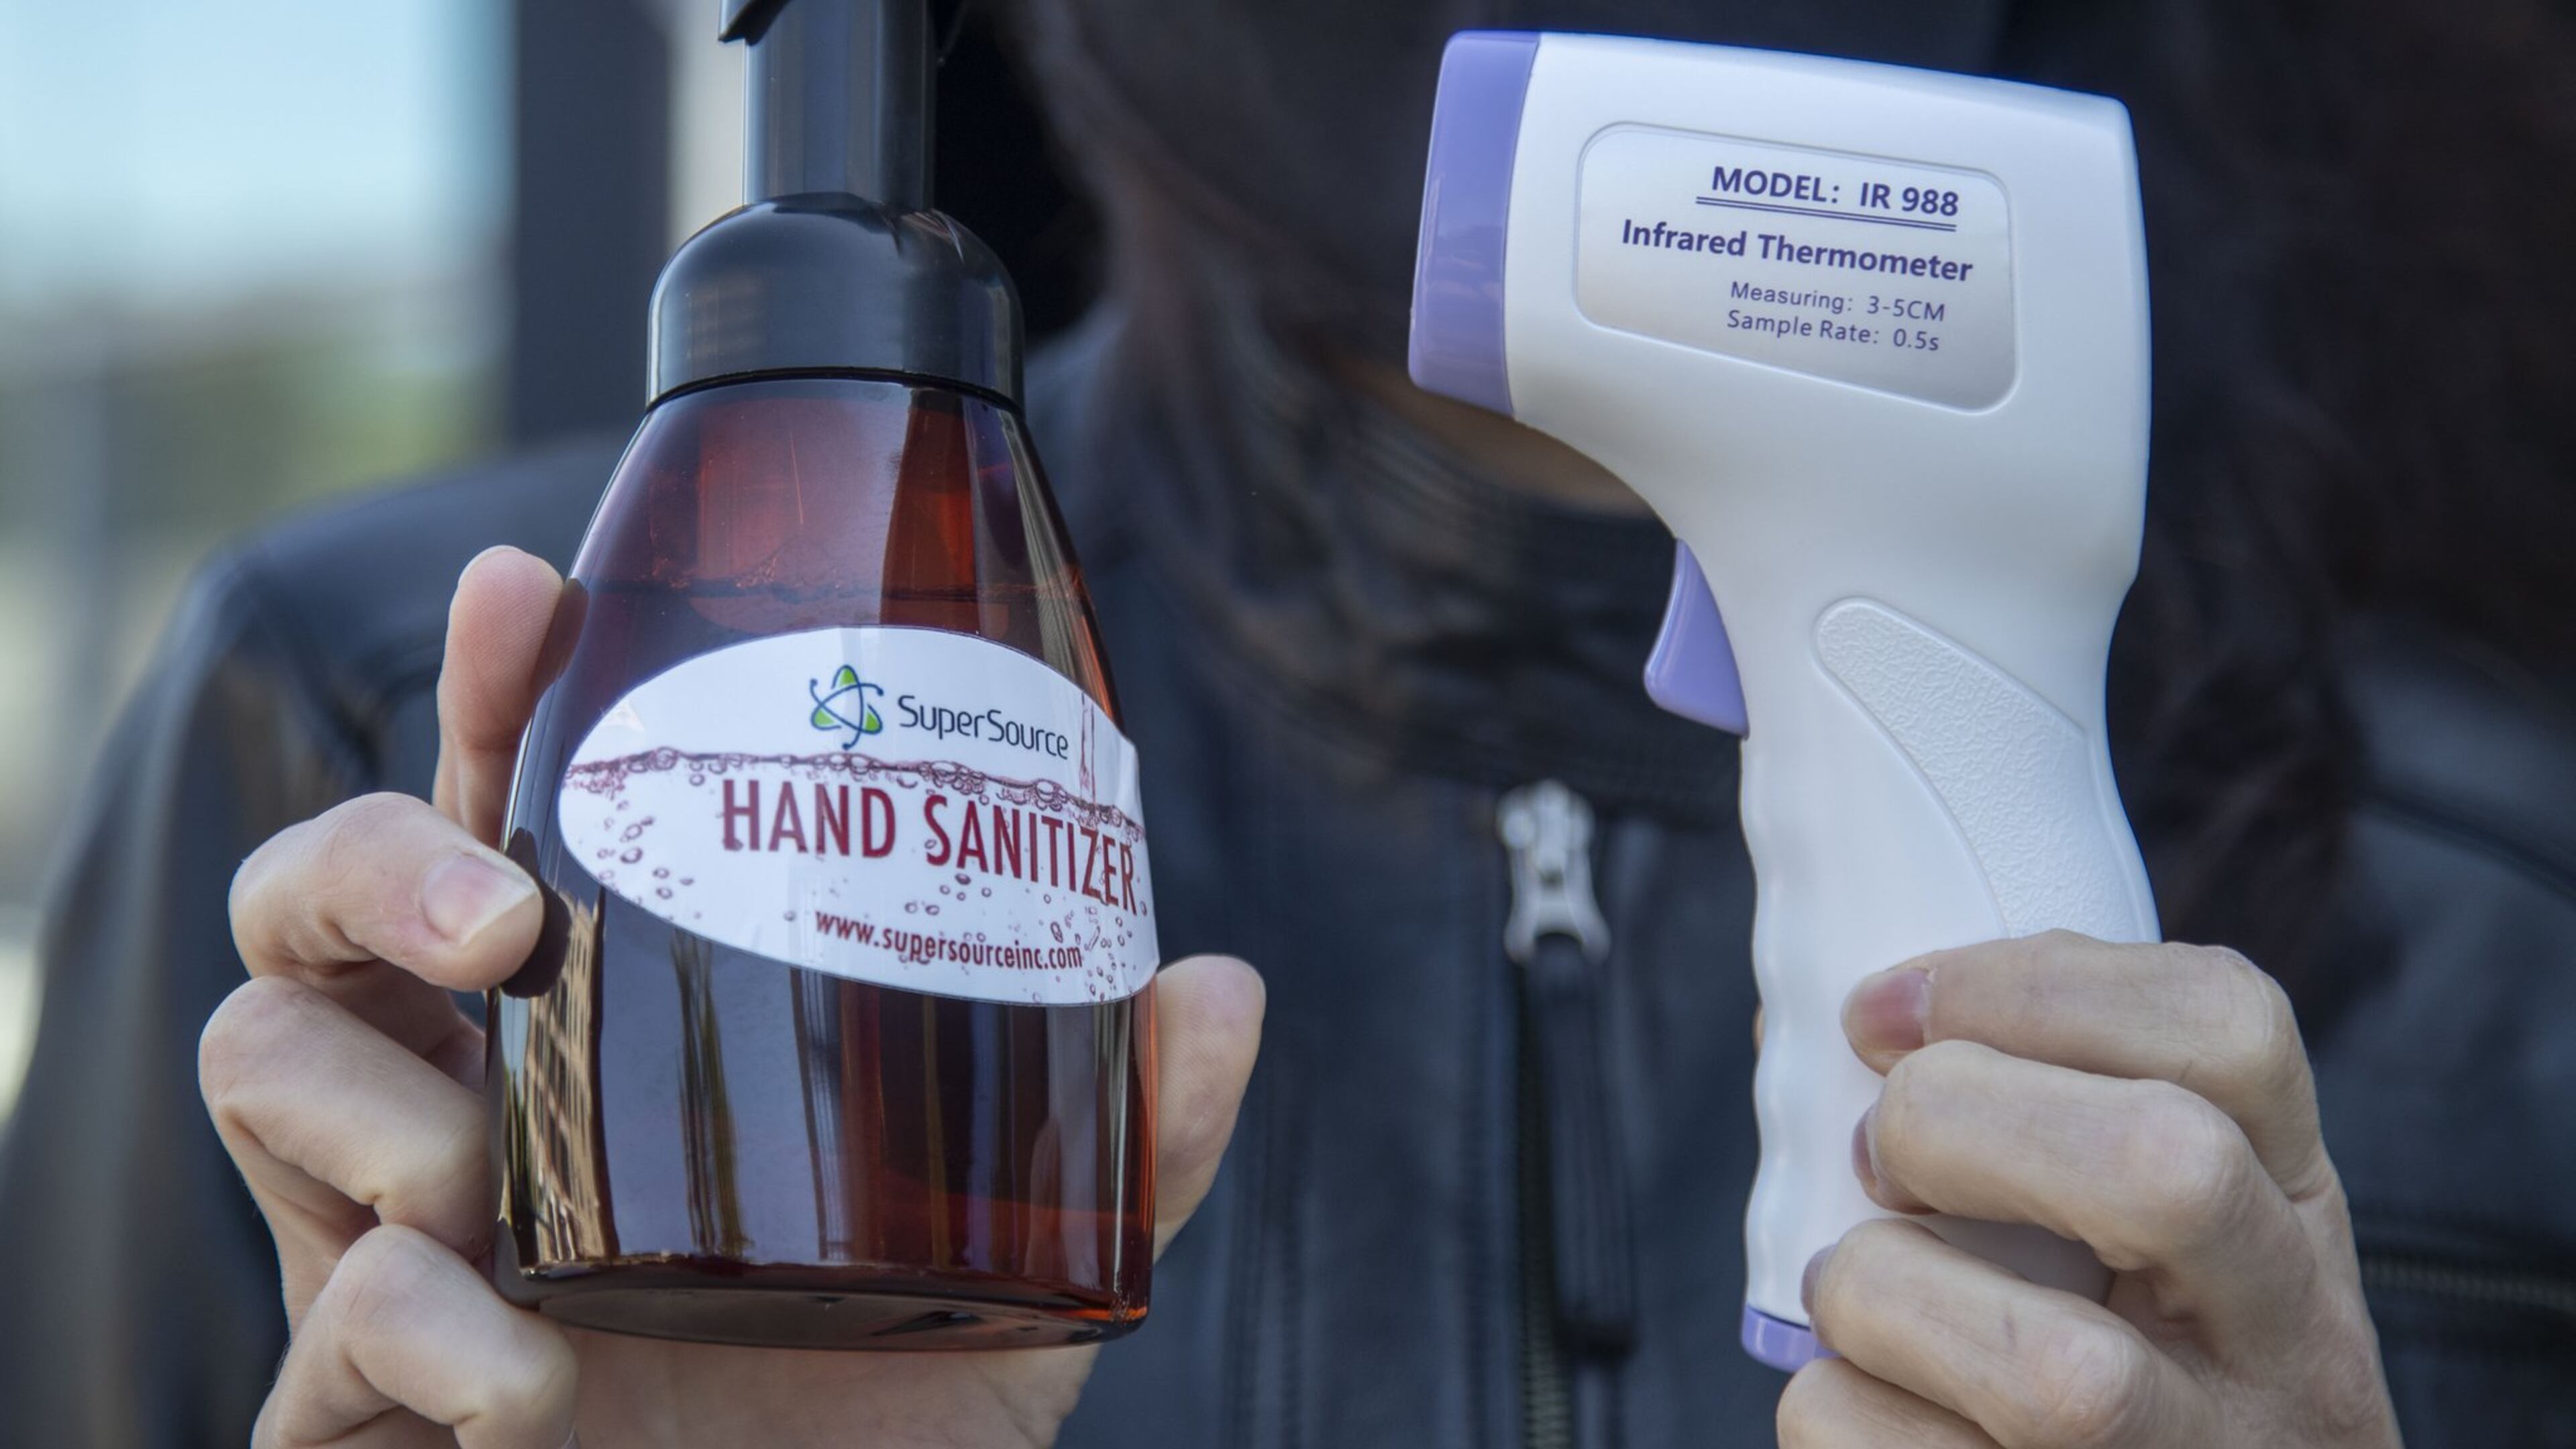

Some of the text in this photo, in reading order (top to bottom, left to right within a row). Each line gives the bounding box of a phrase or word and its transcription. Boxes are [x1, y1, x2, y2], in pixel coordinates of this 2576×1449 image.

[1712, 166, 1960, 217] MODEL: IR 988
[1622, 219, 1974, 282] Infrared Thermometer
[1727, 310, 1940, 352] Sample Rate: 0.5s
[1730, 282, 1946, 322] Measuring: 3-5CM
[898, 695, 1069, 760] SuperSource
[722, 779, 1138, 916] HAND SANITIZER
[815, 911, 1083, 970] www.supersourceinc.com
